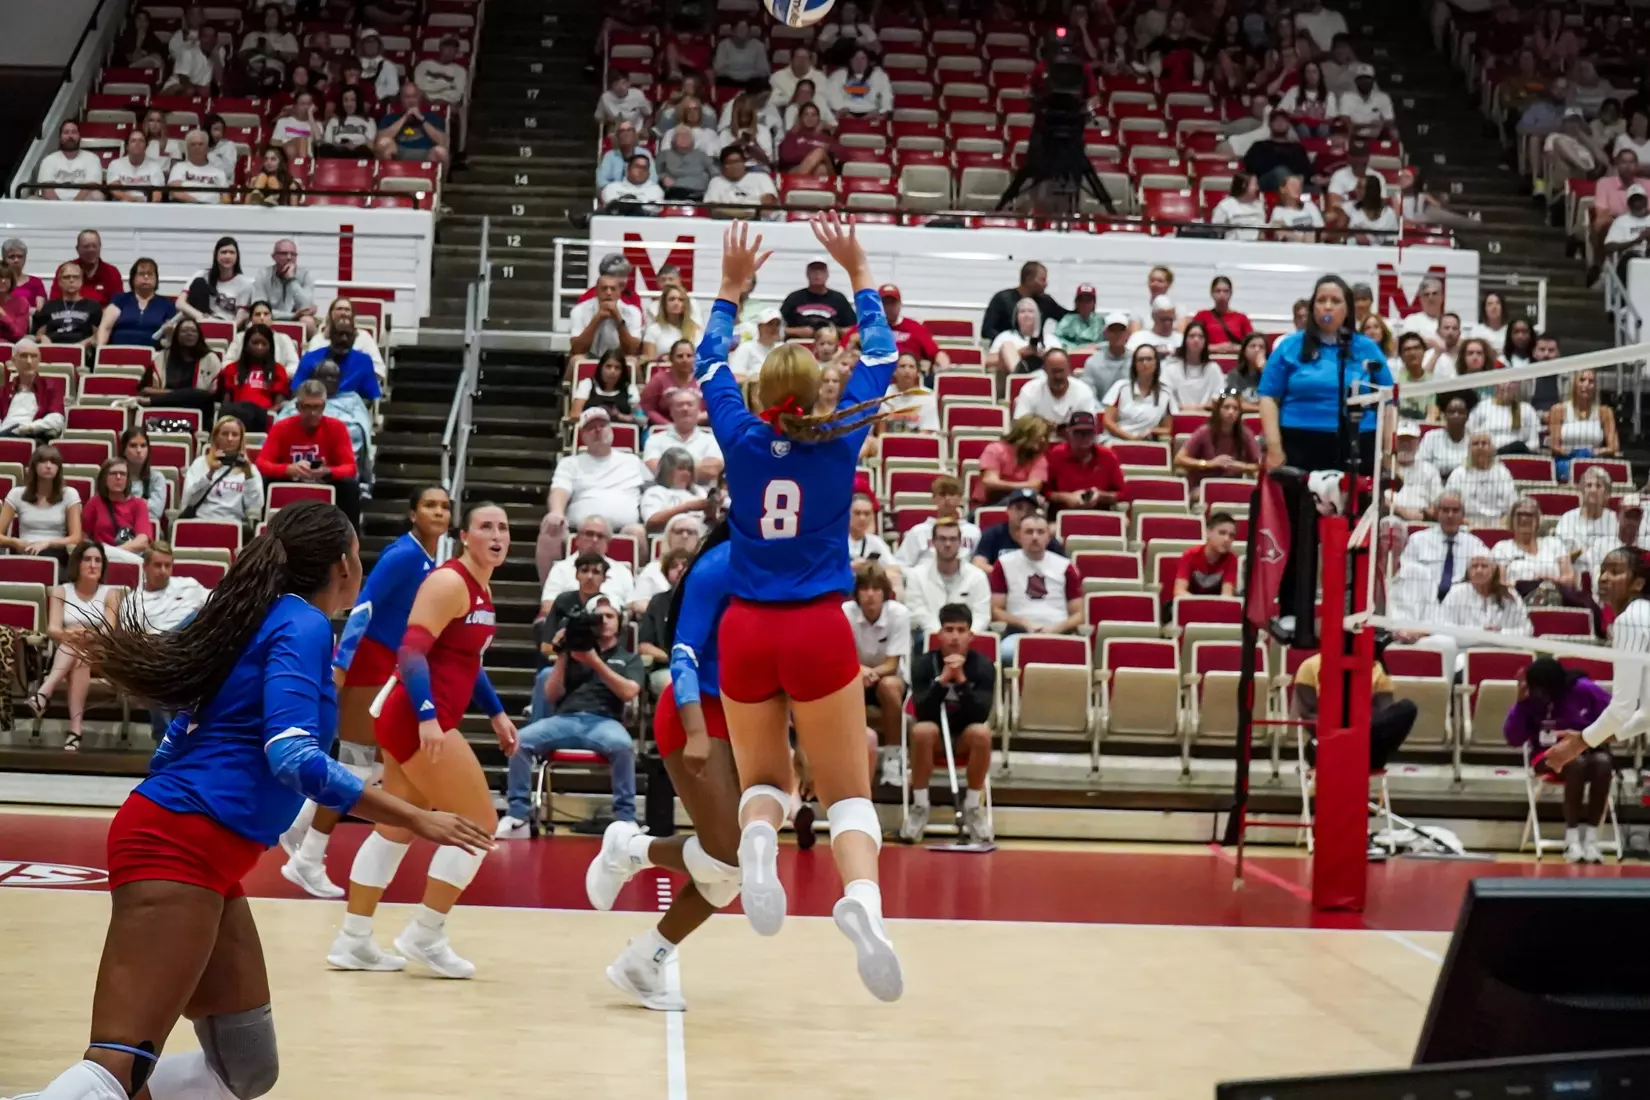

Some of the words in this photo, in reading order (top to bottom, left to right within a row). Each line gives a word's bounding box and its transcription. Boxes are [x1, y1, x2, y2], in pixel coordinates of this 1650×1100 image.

[527, 89, 540, 100] 17
[514, 174, 528, 185] 14
[512, 204, 525, 216] 13
[507, 235, 521, 247] 12
[622, 232, 695, 292] M
[503, 266, 514, 278] 11
[1377, 263, 1446, 319] M
[760, 478, 803, 540] 8
